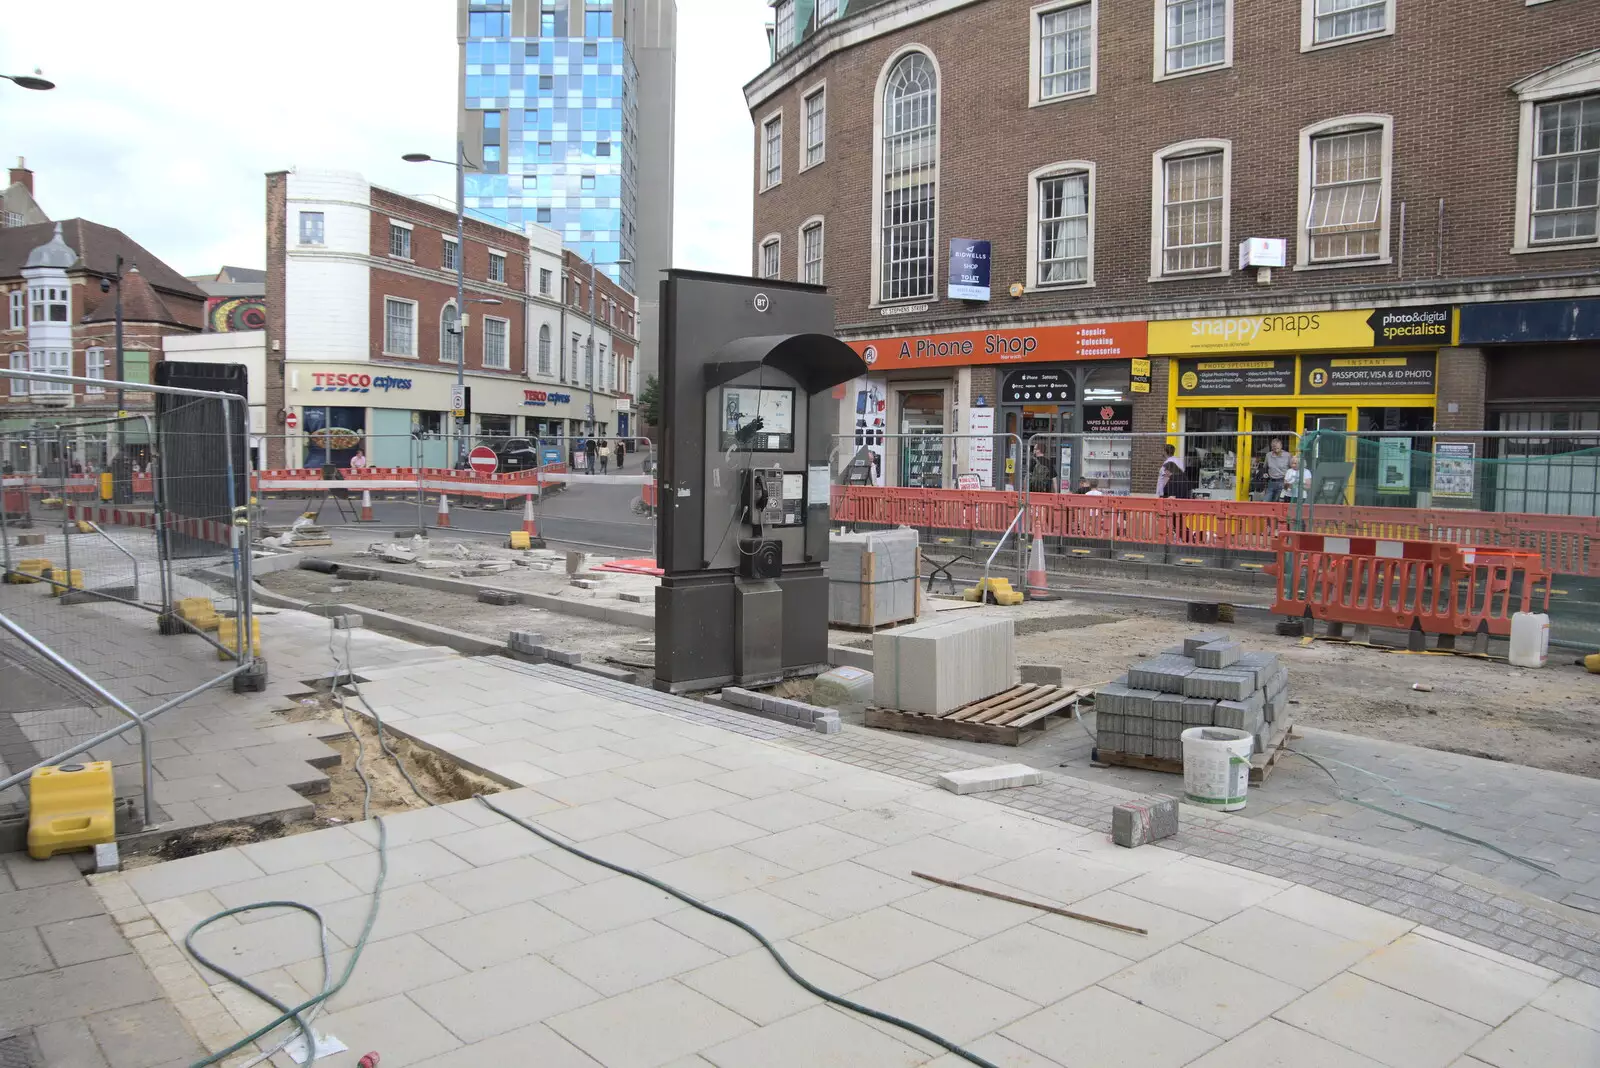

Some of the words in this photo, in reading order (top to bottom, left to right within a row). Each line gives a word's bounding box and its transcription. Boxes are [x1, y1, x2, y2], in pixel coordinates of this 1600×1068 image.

[955, 252, 987, 260] BIDWELLS
[757, 298, 766, 307] BT
[1383, 310, 1447, 326] photo&digital
[1081, 328, 1106, 336] Repairs
[1383, 323, 1446, 340] specialists
[899, 341, 912, 359] A
[916, 339, 974, 358] Phone
[984, 334, 1037, 356] Shop
[1081, 347, 1120, 355] Accessories
[1331, 371, 1369, 379] PASSPORT,
[1405, 370, 1432, 378] PHOTO
[311, 373, 371, 387] TESCO
[373, 375, 412, 392] express
[523, 389, 547, 402] TESCO
[547, 392, 571, 406] express
